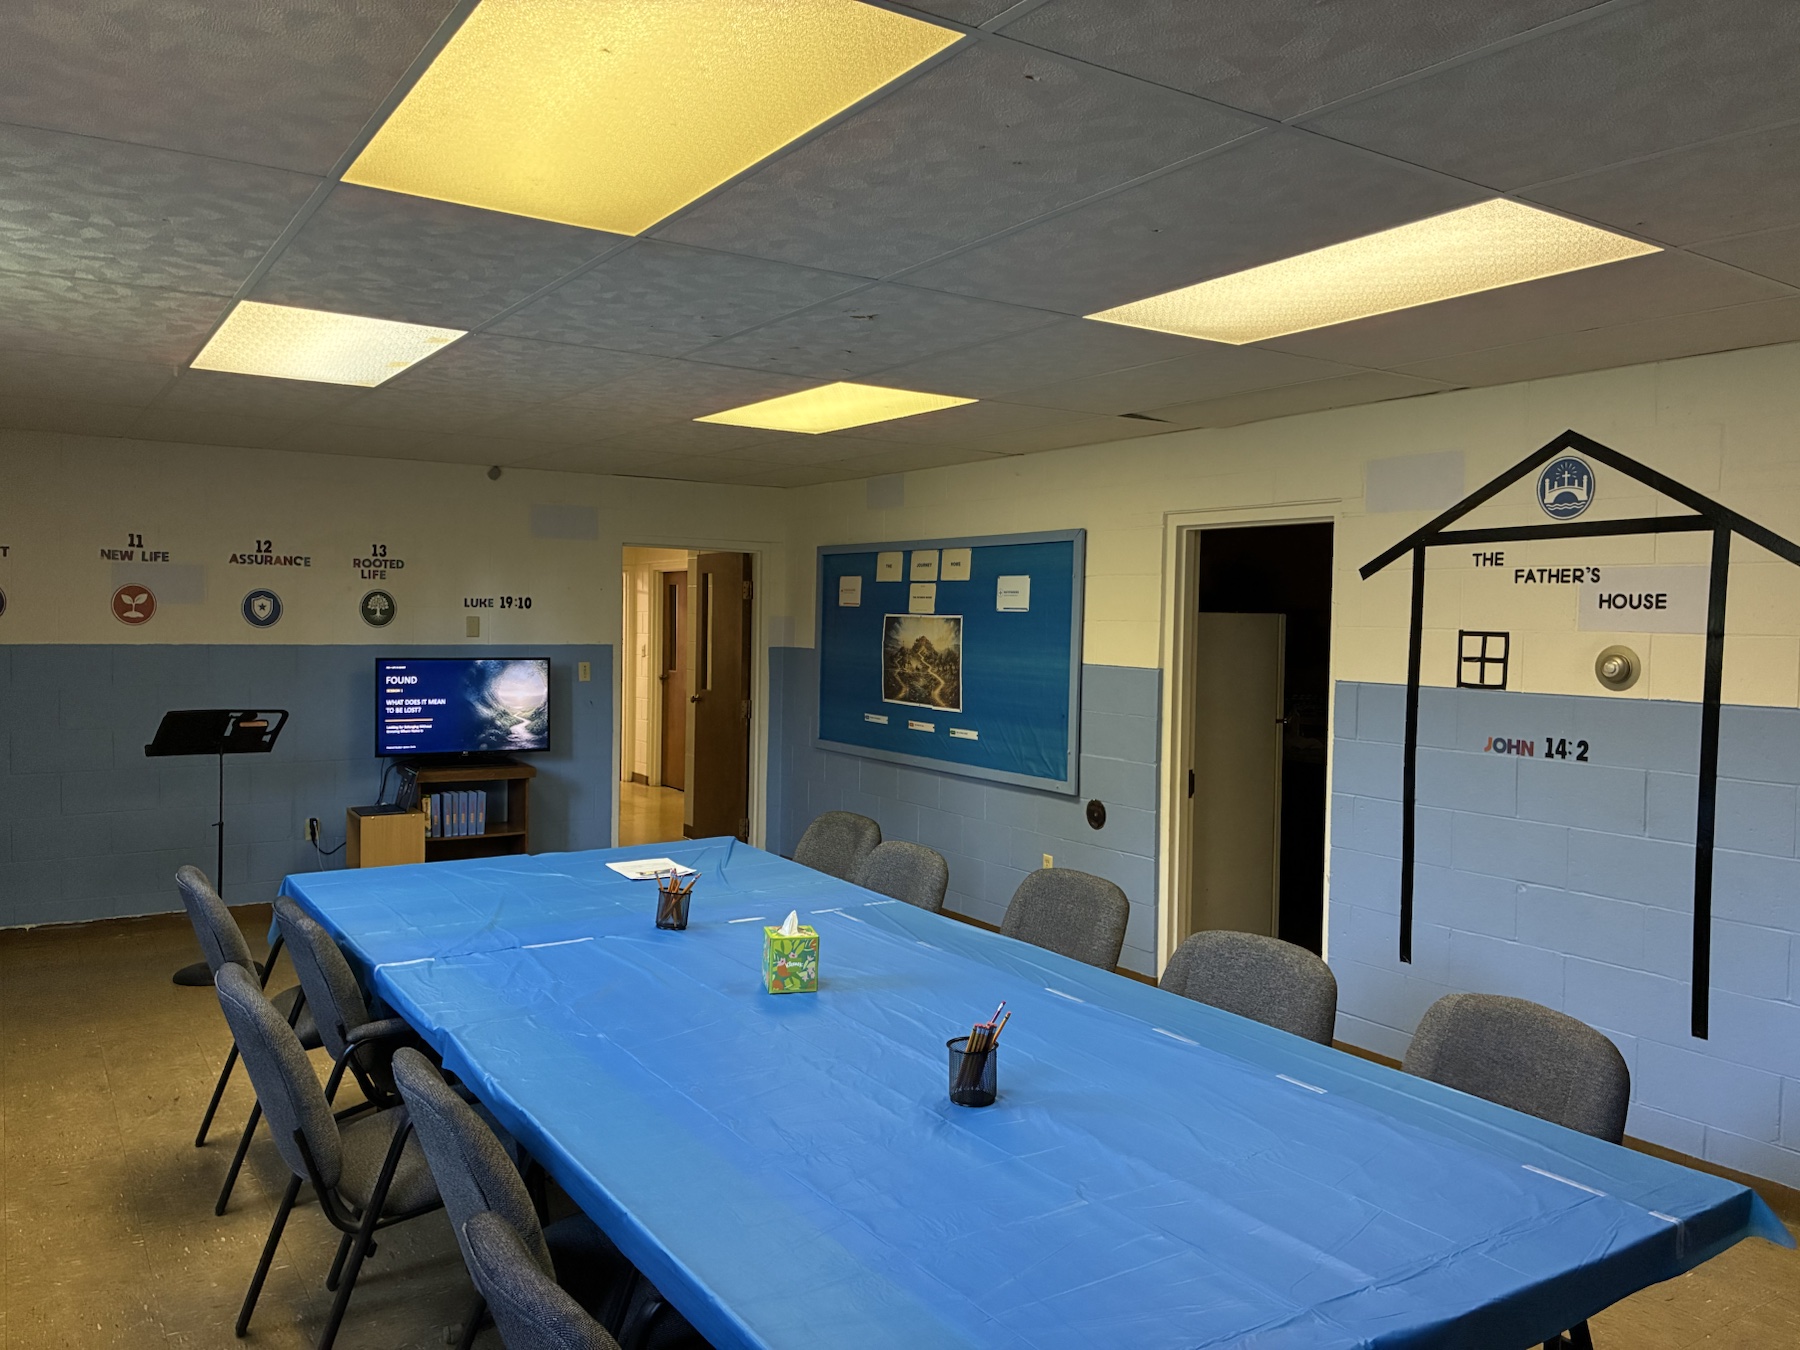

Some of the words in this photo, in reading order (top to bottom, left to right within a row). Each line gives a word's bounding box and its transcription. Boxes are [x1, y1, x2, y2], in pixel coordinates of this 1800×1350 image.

[127, 533, 144, 548] 11
[255, 540, 272, 554] 12
[100, 549, 134, 561] NEW
[141, 551, 170, 562] LIFE
[371, 544, 387, 557] 13
[229, 553, 311, 567] ASSURANCE
[353, 558, 405, 569] ROOTED
[1472, 552, 1504, 567] THE
[361, 570, 387, 580] LIFE
[1514, 567, 1601, 584] FATHER'S
[464, 598, 494, 608] LUKE
[500, 596, 532, 609] 19:10
[1598, 593, 1667, 610] HOUSE
[386, 676, 418, 684] FOUND
[1484, 737, 1534, 757] JOHN
[1545, 737, 1589, 762] 14:2
